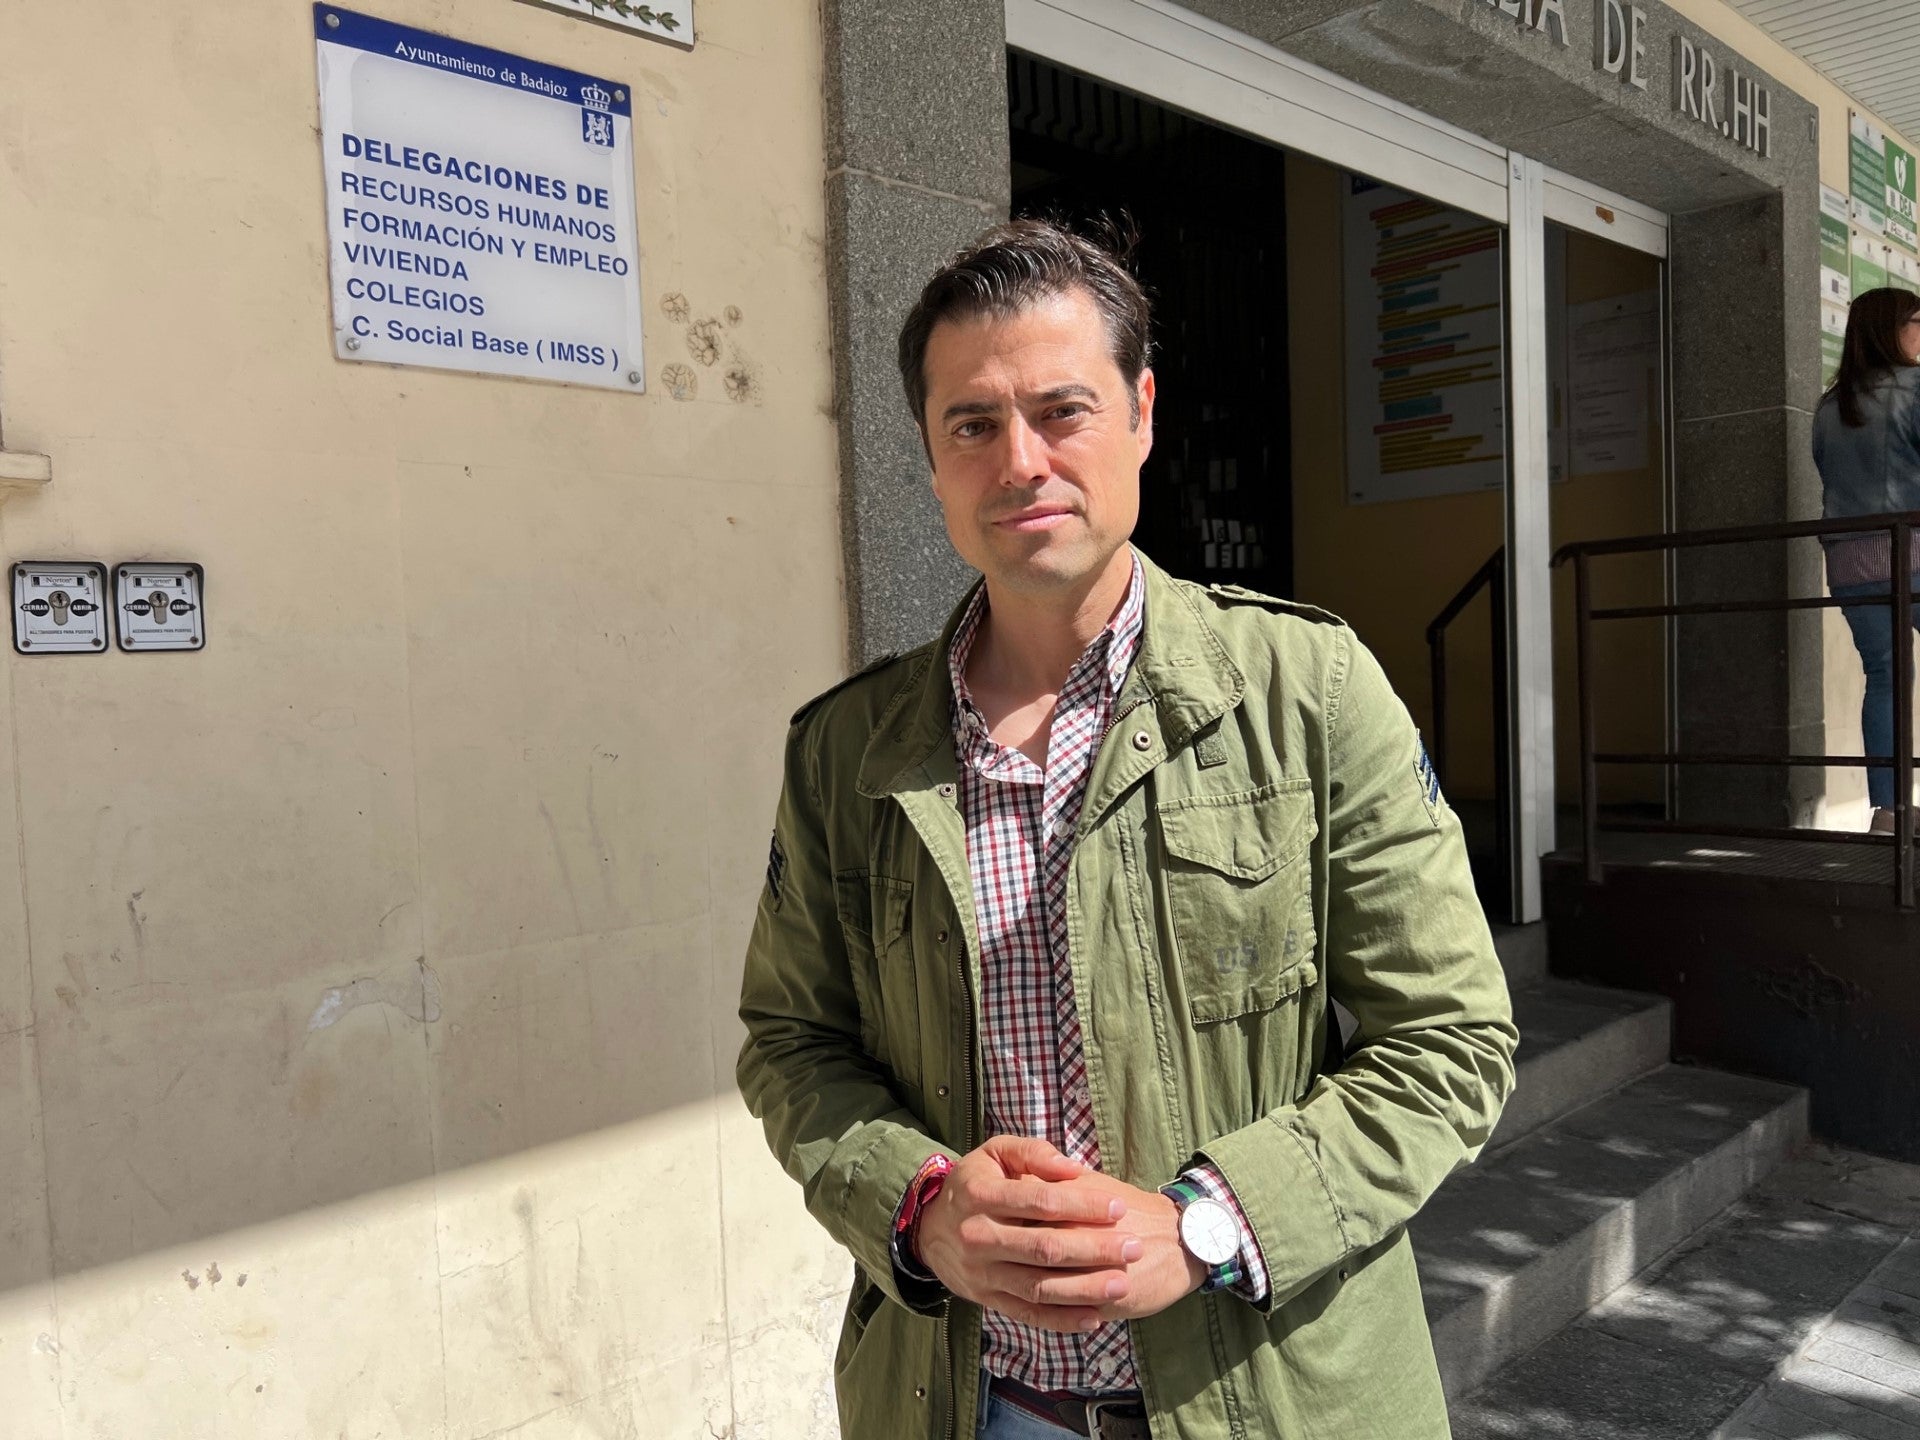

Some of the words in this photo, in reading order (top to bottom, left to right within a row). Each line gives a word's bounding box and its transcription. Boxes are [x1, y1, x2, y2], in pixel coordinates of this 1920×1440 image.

[395, 41, 497, 77] Ayuntamiento
[500, 68, 516, 83] de
[521, 72, 569, 99] Badajoz
[1603, 0, 1647, 91] DE
[1681, 36, 1771, 159] RR.HH
[342, 133, 567, 201] DELEGACIONES
[577, 183, 609, 210] DE
[341, 171, 490, 220] RECURSOS
[498, 203, 617, 244] HUMANOS
[343, 207, 503, 255] FORMACIÓN
[511, 238, 526, 258] Y
[534, 242, 628, 277] EMPLEO
[343, 241, 469, 281] VIVIENDA
[346, 277, 485, 317] COLEGIOS
[352, 315, 379, 339] C.
[387, 319, 463, 349] Social
[472, 331, 529, 356] Base
